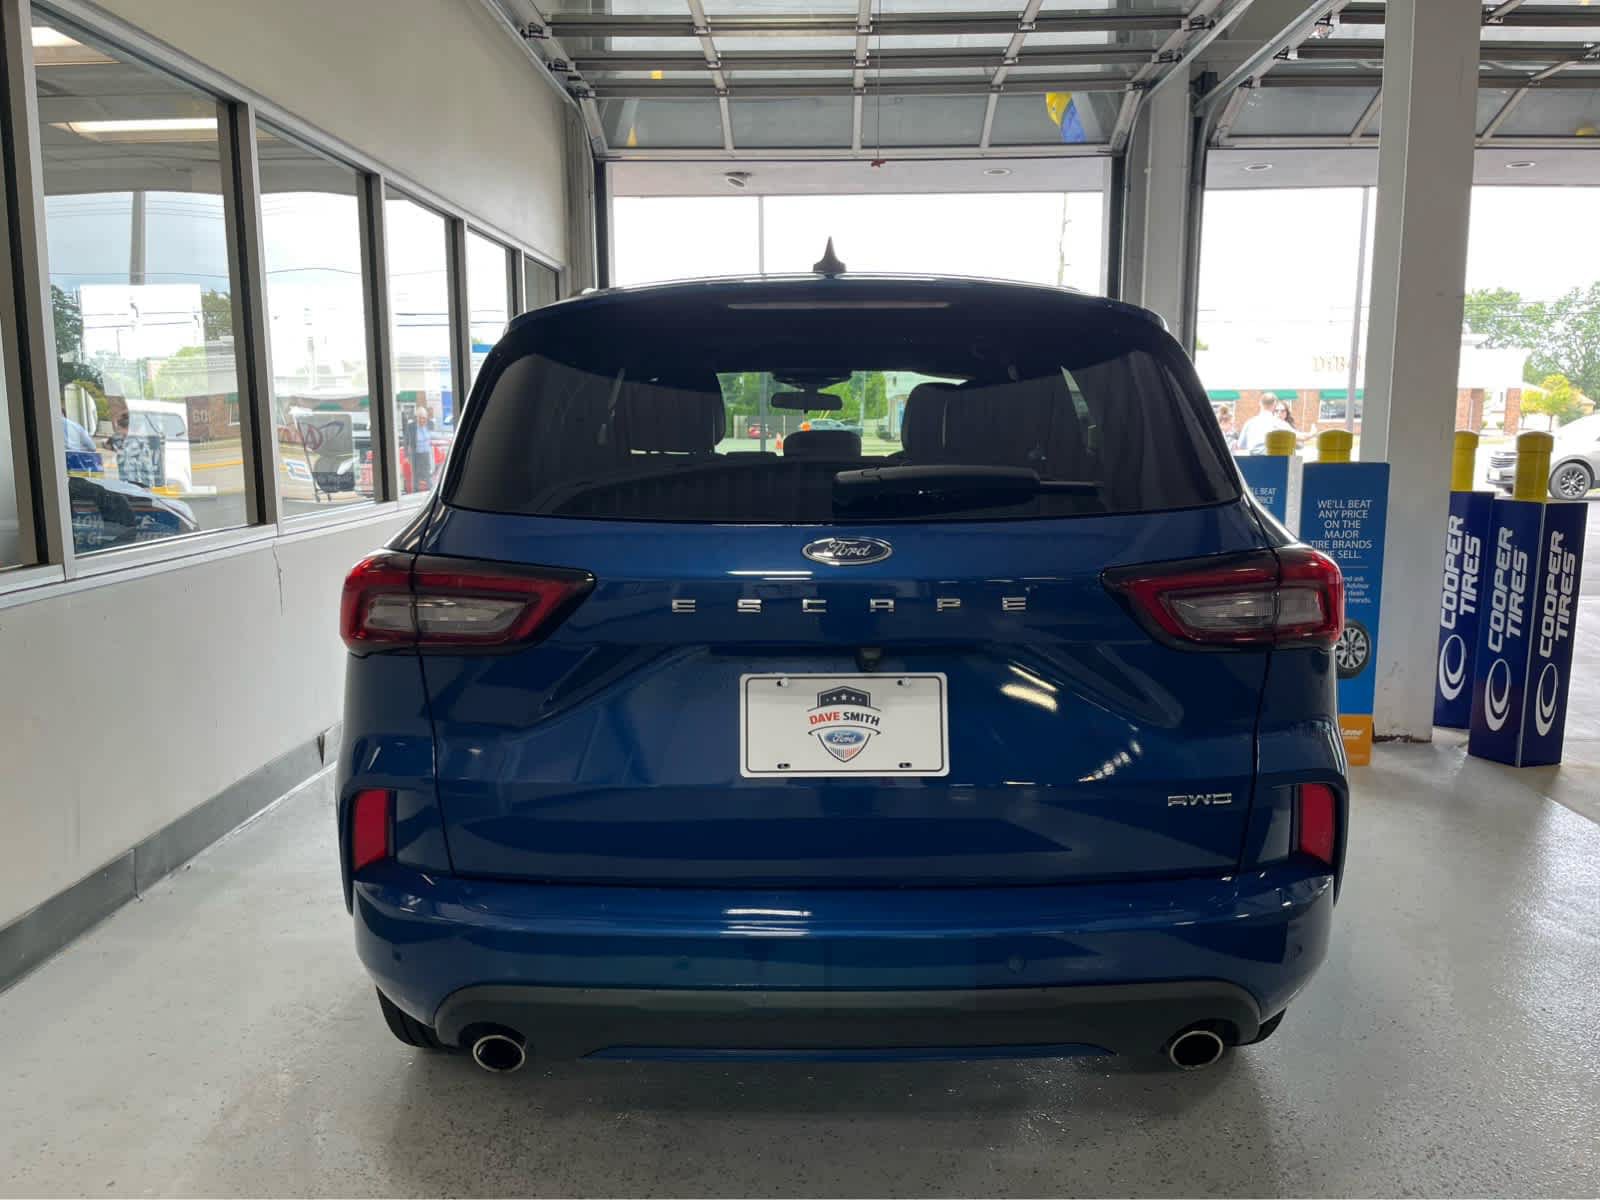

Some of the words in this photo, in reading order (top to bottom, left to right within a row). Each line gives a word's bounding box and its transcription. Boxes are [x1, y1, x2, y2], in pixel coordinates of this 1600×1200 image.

[1318, 499, 1345, 509] WE'LL
[1348, 499, 1373, 509] BEAT
[1318, 509, 1339, 519] ANY
[1341, 509, 1369, 519] PRICE
[1324, 519, 1340, 529] ON
[1343, 519, 1361, 529] THE
[1324, 530, 1360, 539] MAJOR
[1311, 540, 1330, 549] TIRE
[1332, 540, 1373, 549] BRANDS
[1337, 550, 1362, 559] SELL.
[1441, 515, 1464, 630] COOPER
[1459, 534, 1481, 615] TIRES
[1488, 526, 1513, 653] COOPER
[1506, 549, 1528, 639] TIRES
[1539, 530, 1564, 658] COOPER
[1555, 551, 1575, 641] TIRES
[671, 597, 1026, 613] ESCAPE
[809, 711, 841, 725] DAVE
[842, 711, 881, 726] SMITH
[1167, 793, 1232, 807] AWD
